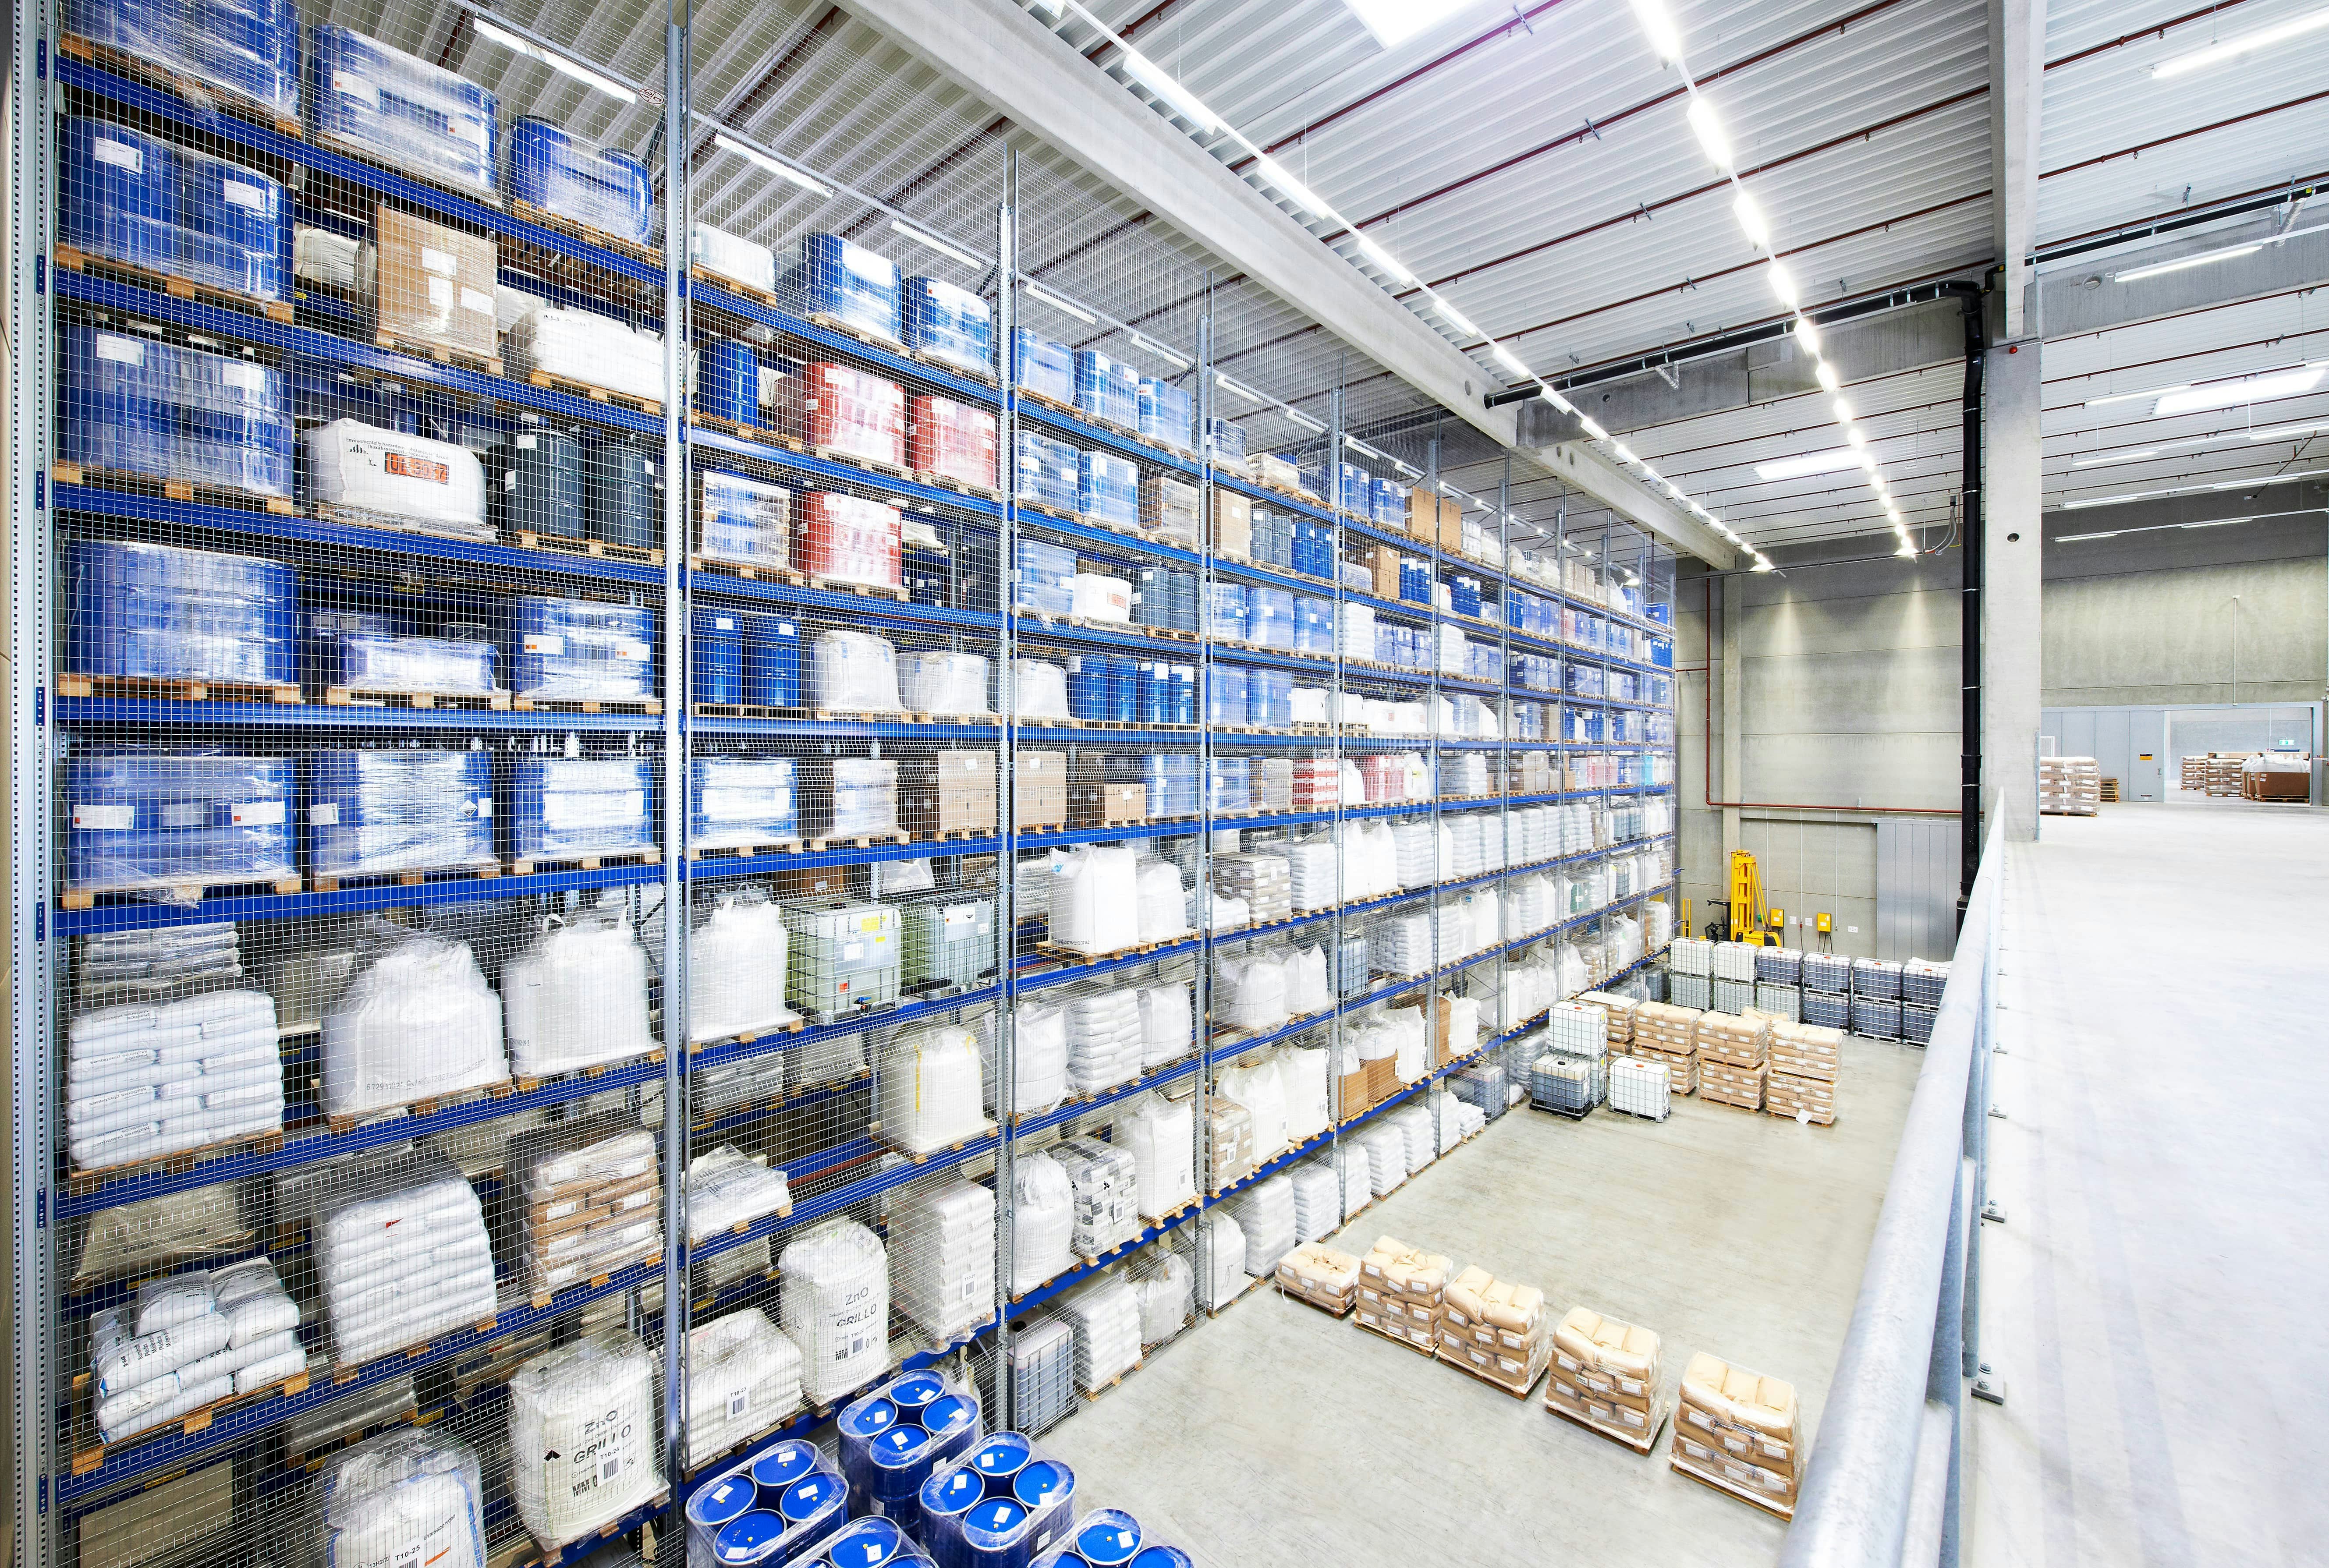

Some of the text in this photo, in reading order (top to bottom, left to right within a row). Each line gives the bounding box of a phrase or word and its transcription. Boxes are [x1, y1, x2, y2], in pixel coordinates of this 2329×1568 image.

[346, 438, 382, 446] Environmentally
[368, 444, 431, 459] (hexabromocyclodecane)
[413, 461, 446, 479] 307
[89, 1094, 120, 1106] plastiques
[846, 1287, 869, 1306] ZnO
[837, 1303, 876, 1327] GRILLO
[730, 1386, 746, 1398] T10-23
[585, 1410, 618, 1435] ZnO
[600, 1446, 620, 1460] T10-24
[395, 1544, 420, 1561] T10-25
